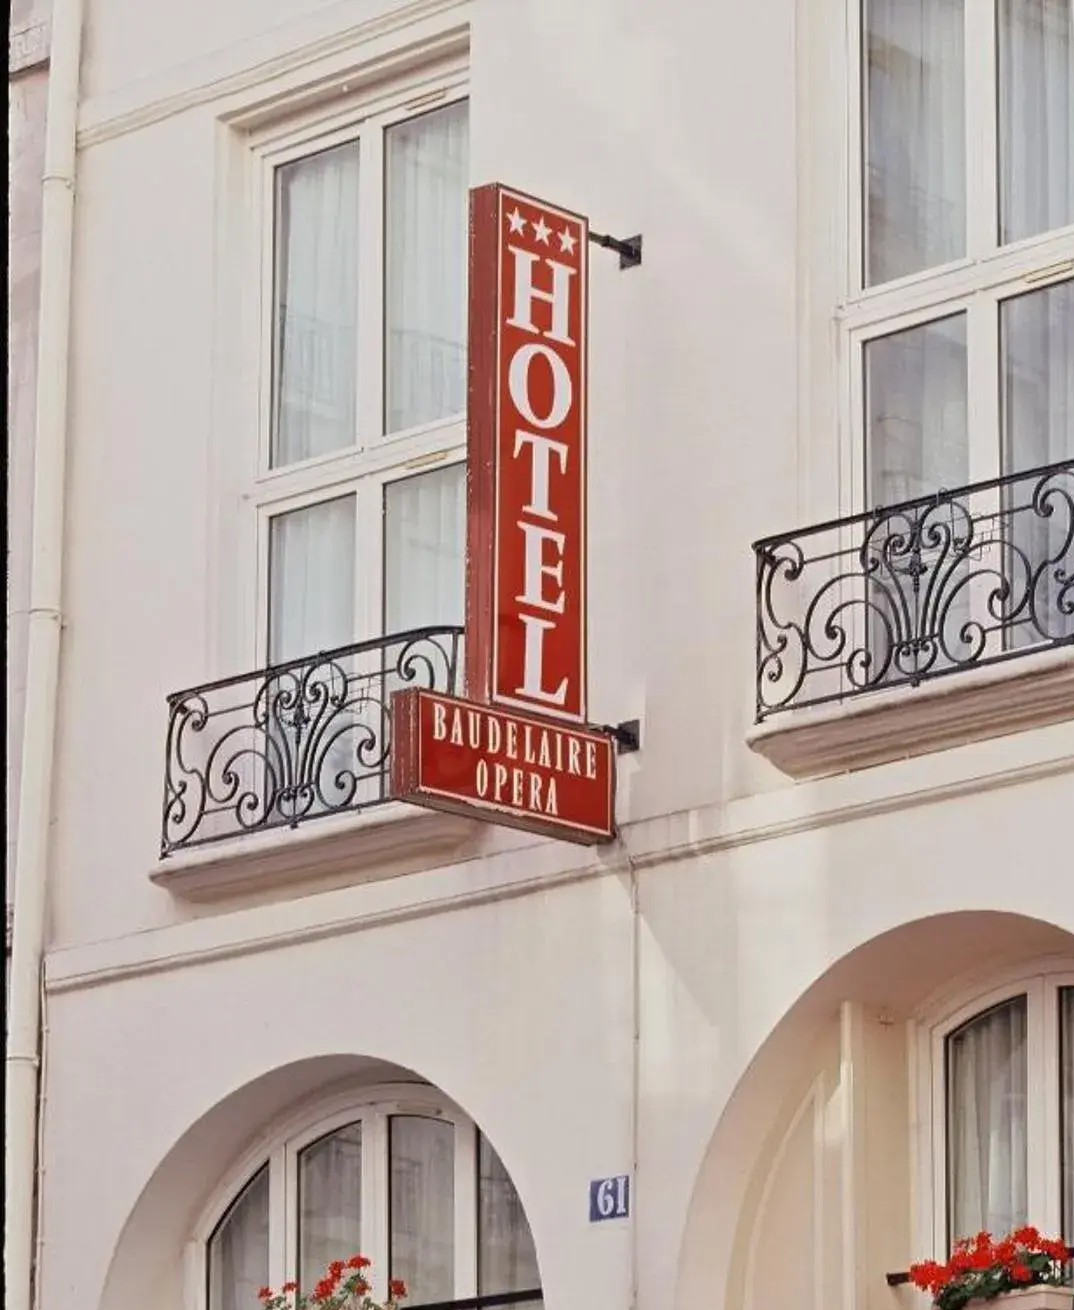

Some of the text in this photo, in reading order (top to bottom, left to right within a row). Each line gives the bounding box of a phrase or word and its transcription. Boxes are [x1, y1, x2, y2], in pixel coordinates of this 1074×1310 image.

[505, 245, 577, 706] HOTEL
[432, 702, 598, 780] BAUDELAIRE
[475, 758, 559, 817] OPERA
[597, 1177, 626, 1216] 61
